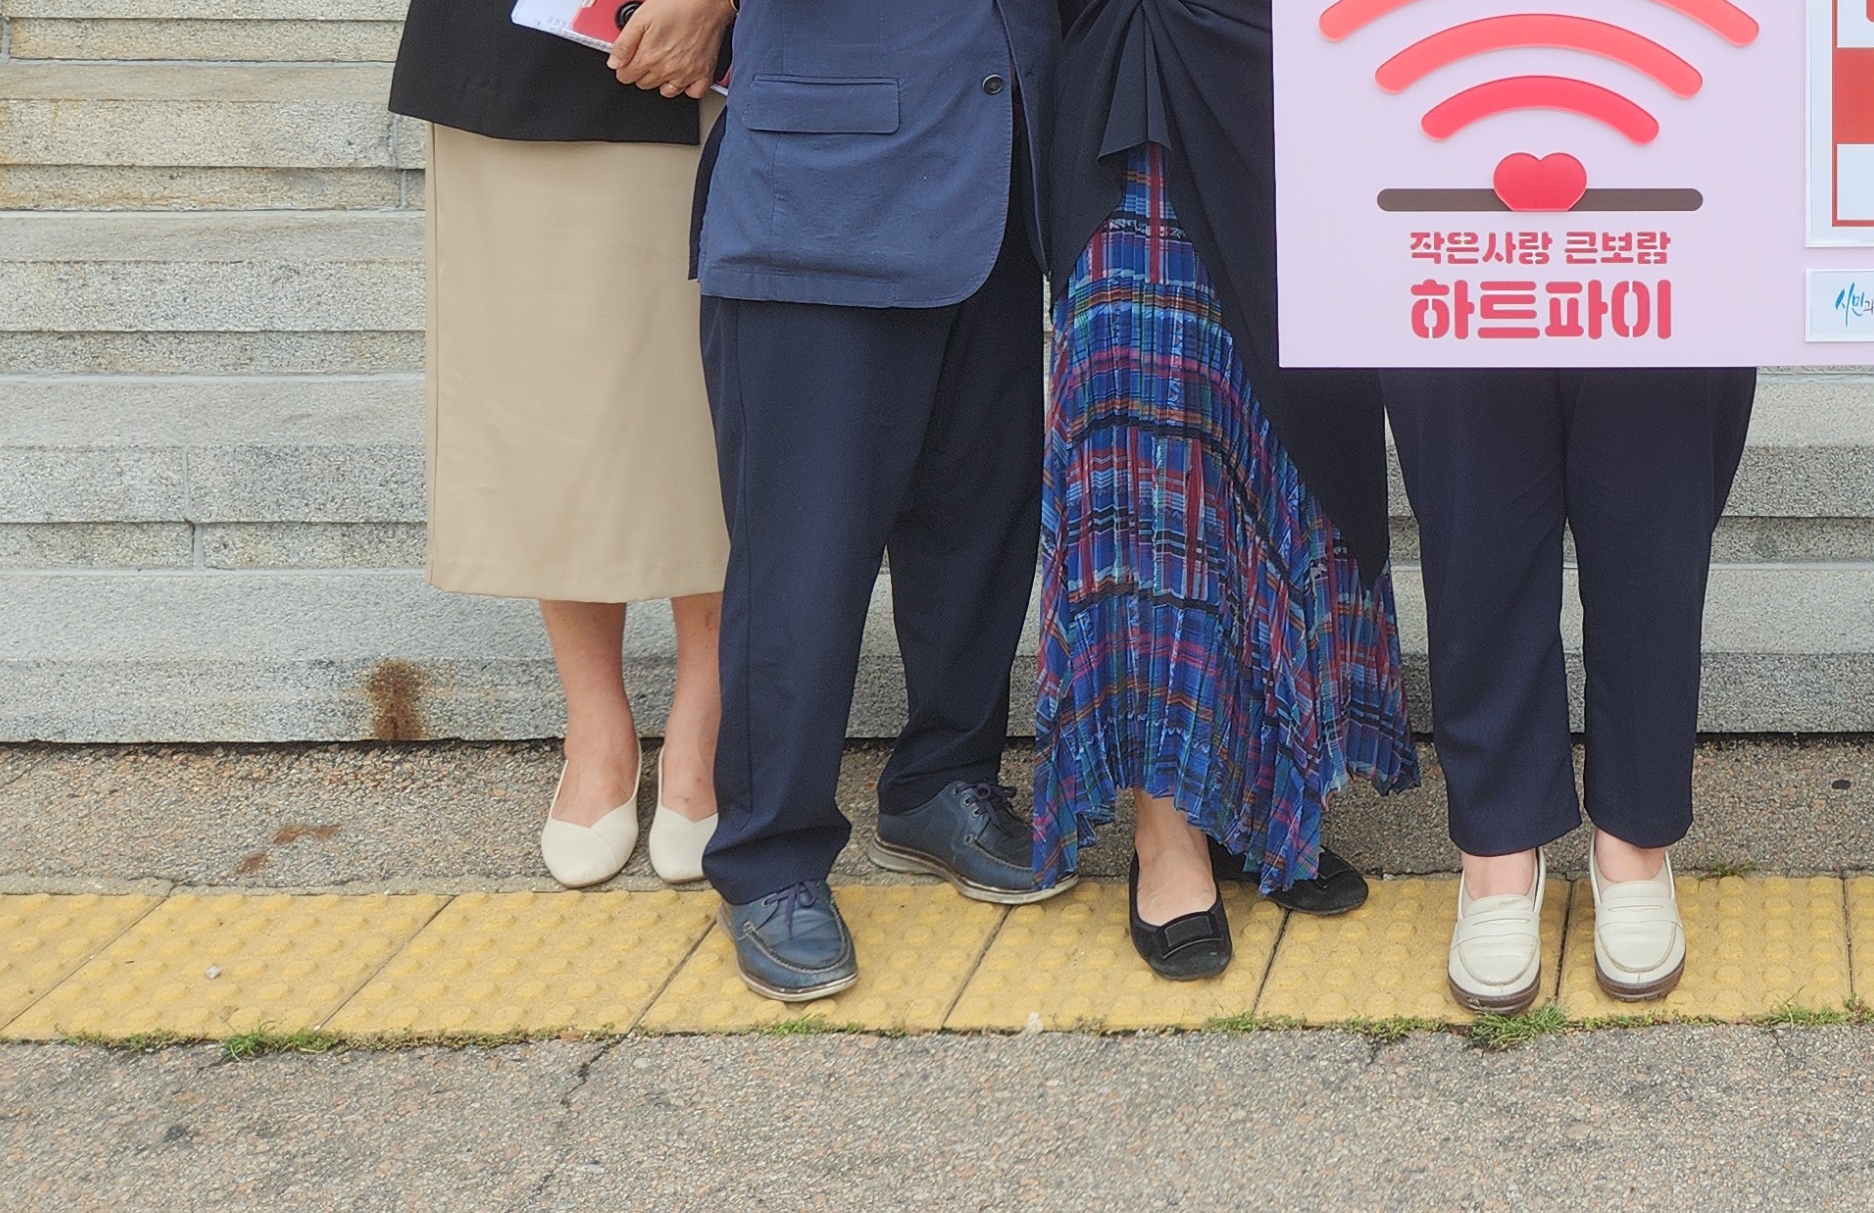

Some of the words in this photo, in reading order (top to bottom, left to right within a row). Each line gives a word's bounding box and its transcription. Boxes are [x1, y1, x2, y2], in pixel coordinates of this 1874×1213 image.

[1409, 231, 1554, 265] 작은사랑
[1563, 231, 1672, 265] 큰보람
[1410, 278, 1673, 340] 하트파이
